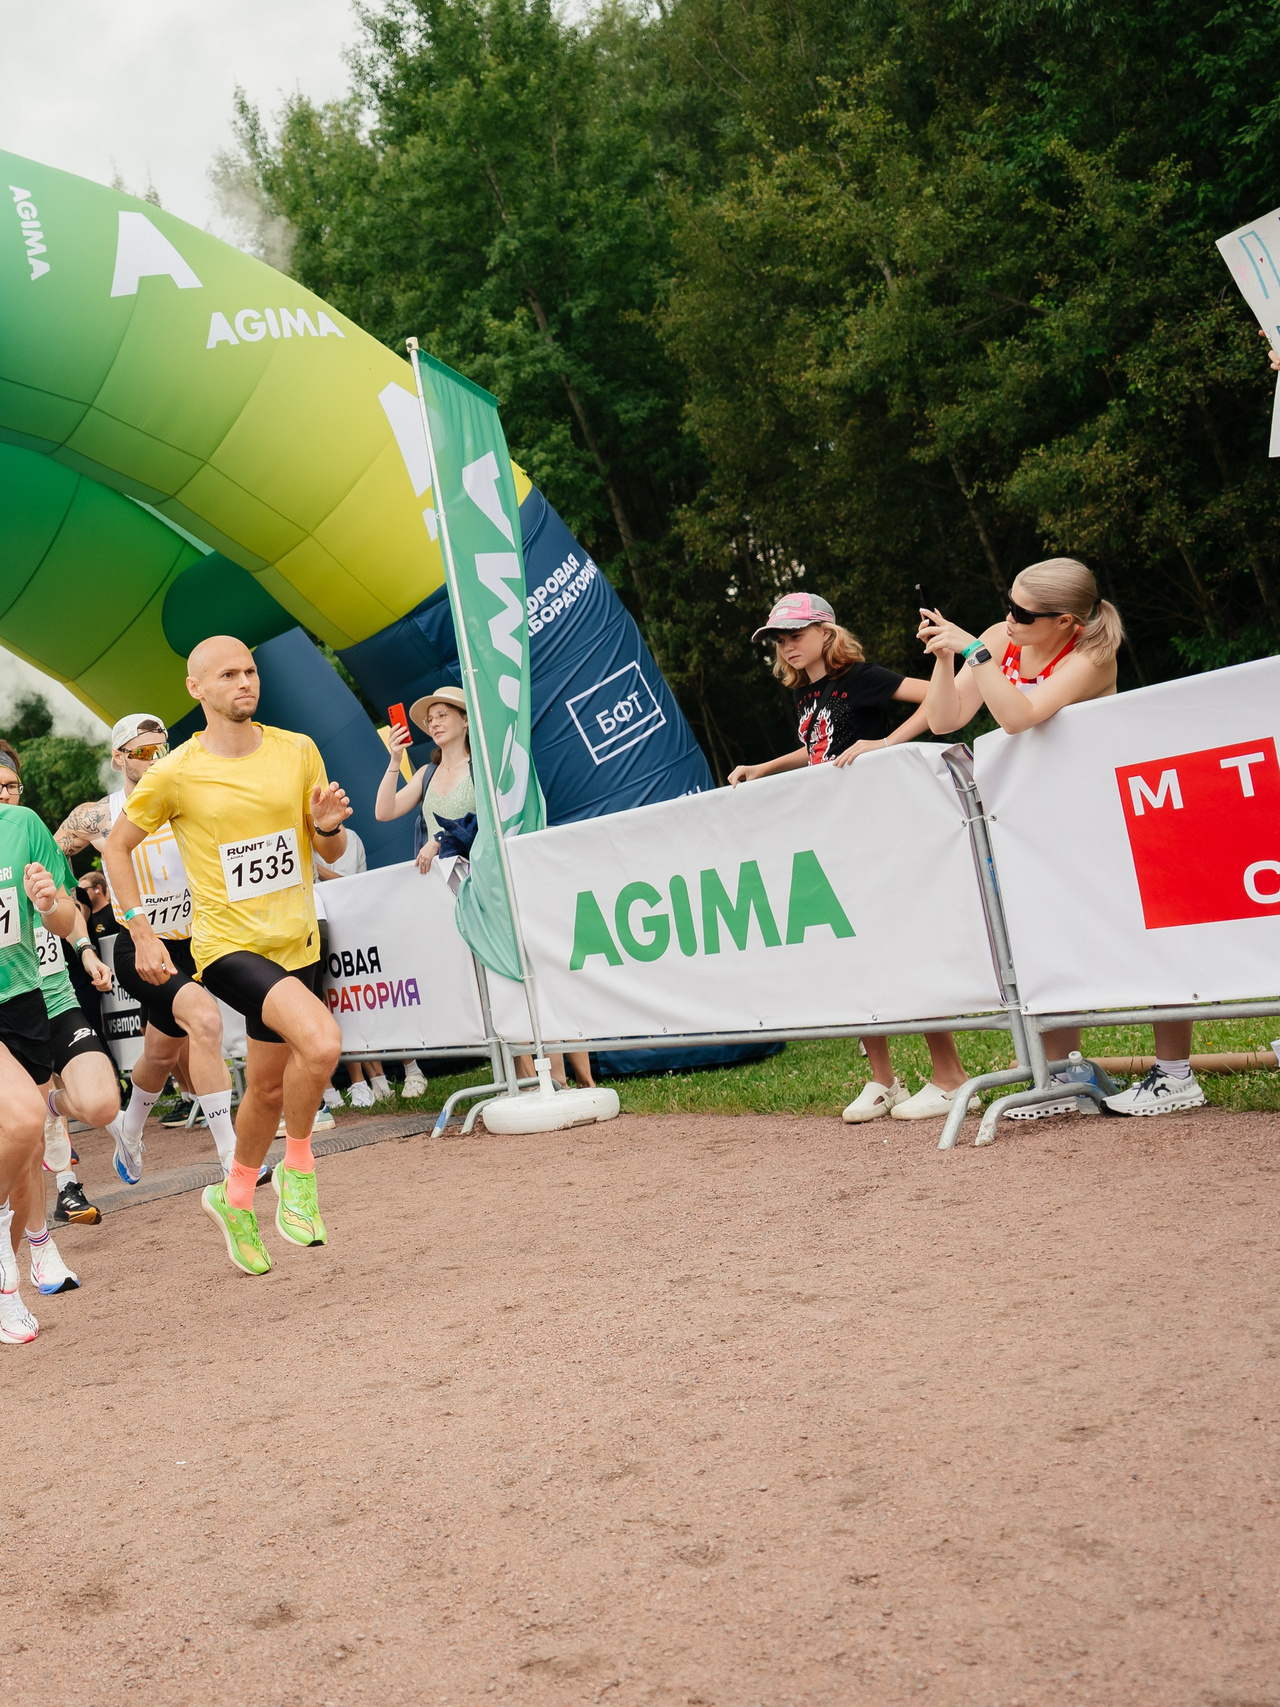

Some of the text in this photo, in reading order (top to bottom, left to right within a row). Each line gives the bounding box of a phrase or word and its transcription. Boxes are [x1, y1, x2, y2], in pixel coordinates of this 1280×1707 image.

[8, 184, 51, 281] AGIMA
[206, 307, 346, 349] AGIMA
[595, 691, 643, 735] БФТ
[227, 841, 264, 856] RUNIT
[276, 835, 288, 852] A
[231, 850, 294, 887] 1535
[145, 895, 174, 904] RUNIT
[183, 888, 191, 900] A
[148, 901, 191, 925] 1179
[569, 849, 856, 971] AGIMA
[324, 946, 382, 978] ОВАЯ
[323, 978, 421, 1014] РАТОРИЯ
